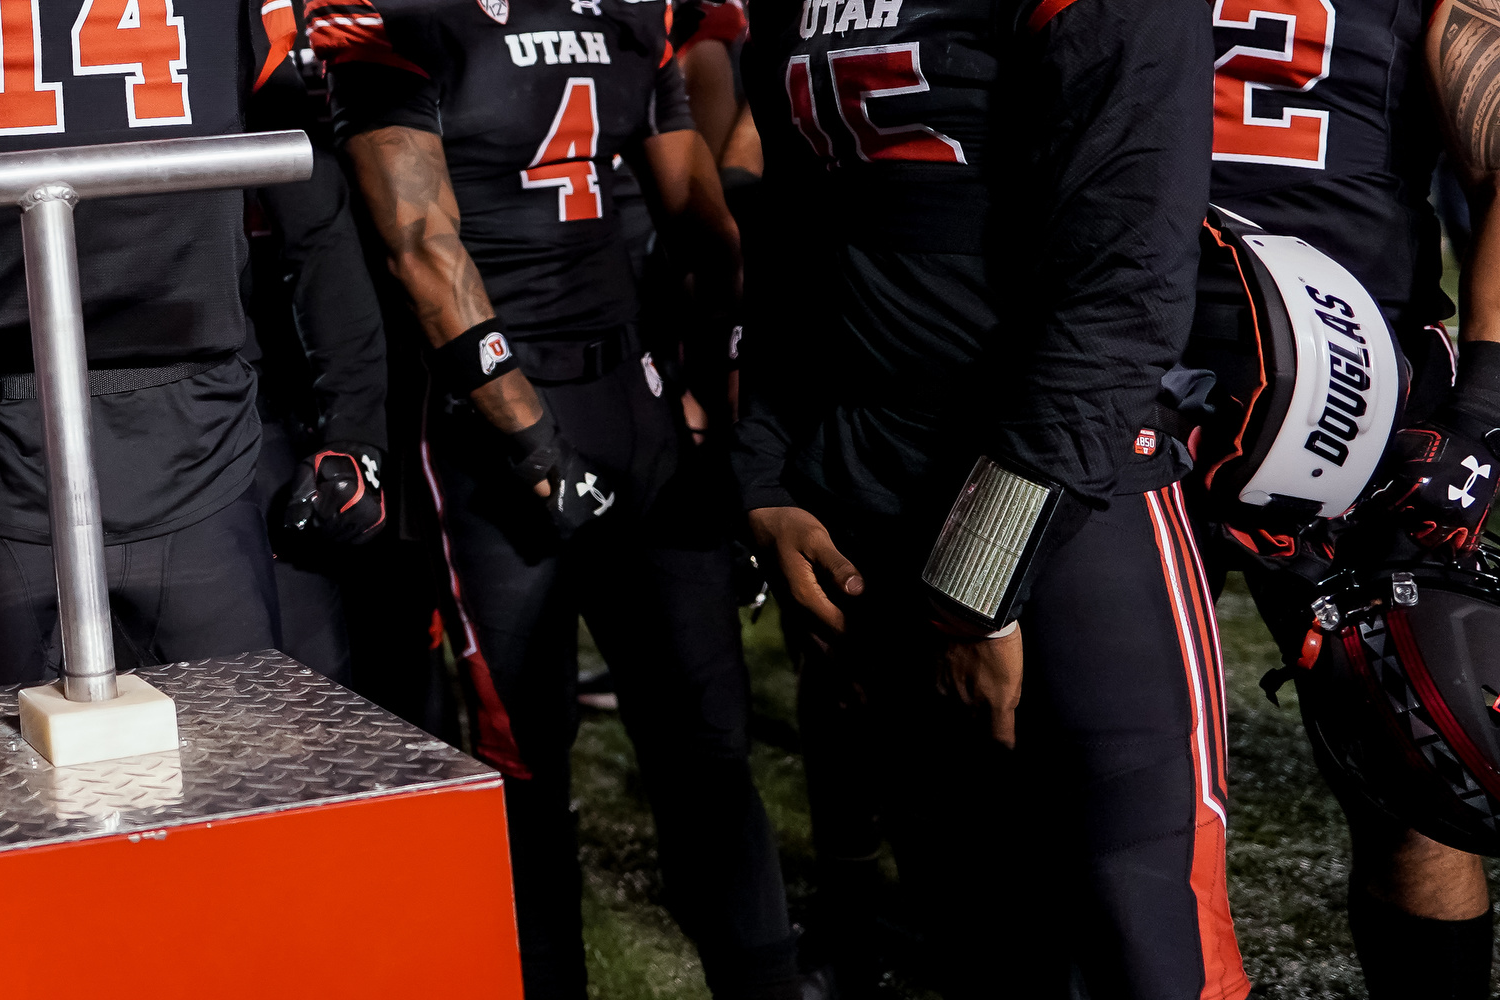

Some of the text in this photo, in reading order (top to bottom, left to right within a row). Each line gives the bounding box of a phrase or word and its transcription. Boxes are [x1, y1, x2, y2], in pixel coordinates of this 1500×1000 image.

[505, 31, 610, 67] UTAH
[520, 77, 602, 222] 4
[1304, 285, 1370, 467] DOUGLAS
[1136, 437, 1155, 448] 1850
